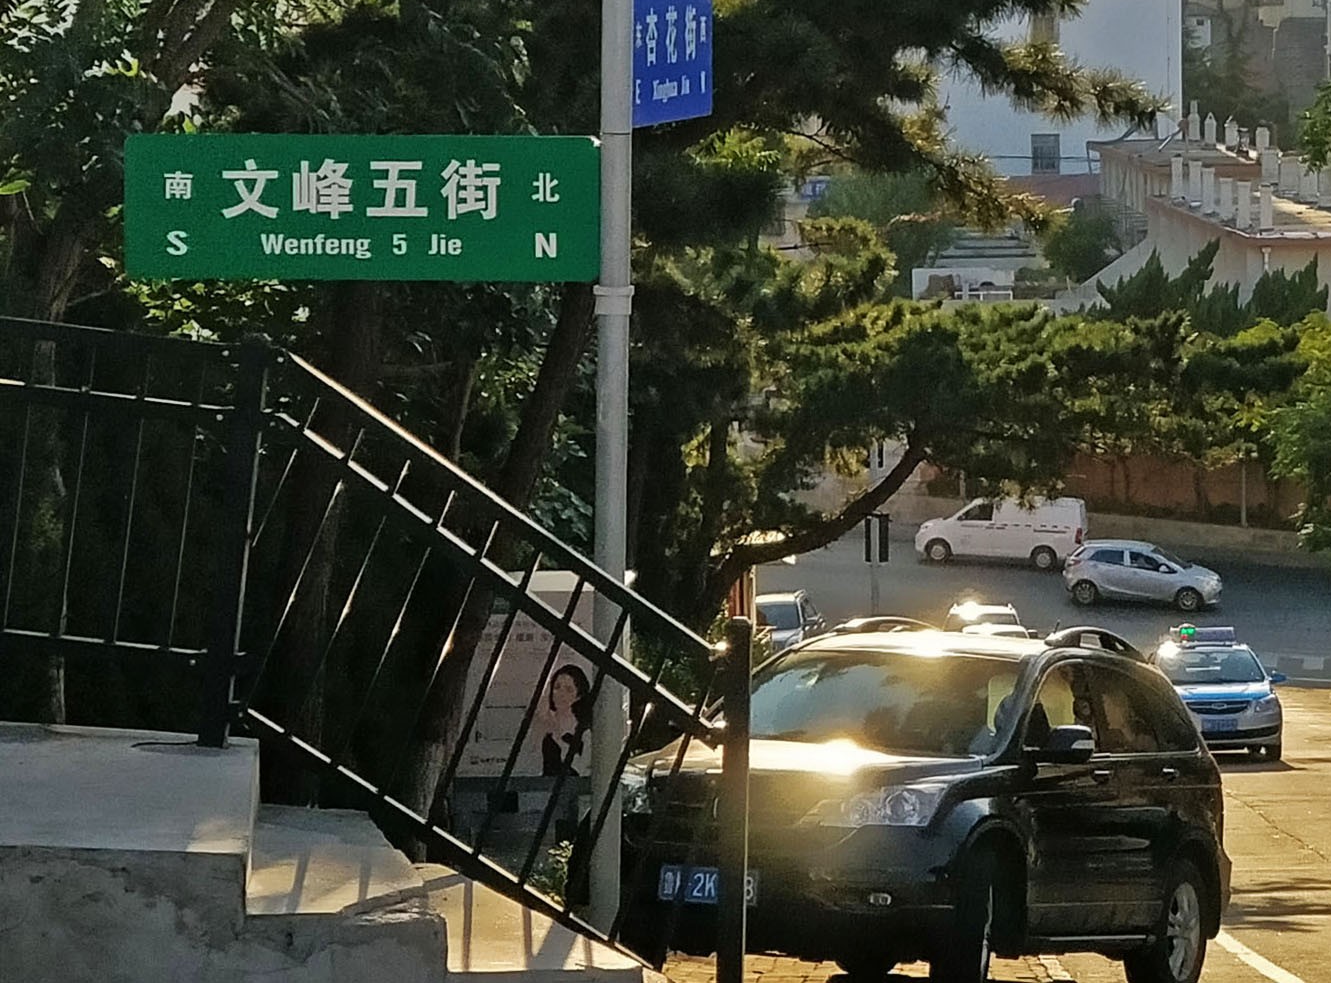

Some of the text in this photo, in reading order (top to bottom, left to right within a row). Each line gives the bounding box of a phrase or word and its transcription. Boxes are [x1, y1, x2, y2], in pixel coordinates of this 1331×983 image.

[646, 4, 697, 67] 杏花街
[164, 159, 559, 219] 南 文峰五街 北
[167, 231, 556, 258] S Wenfeng 5 Jie N
